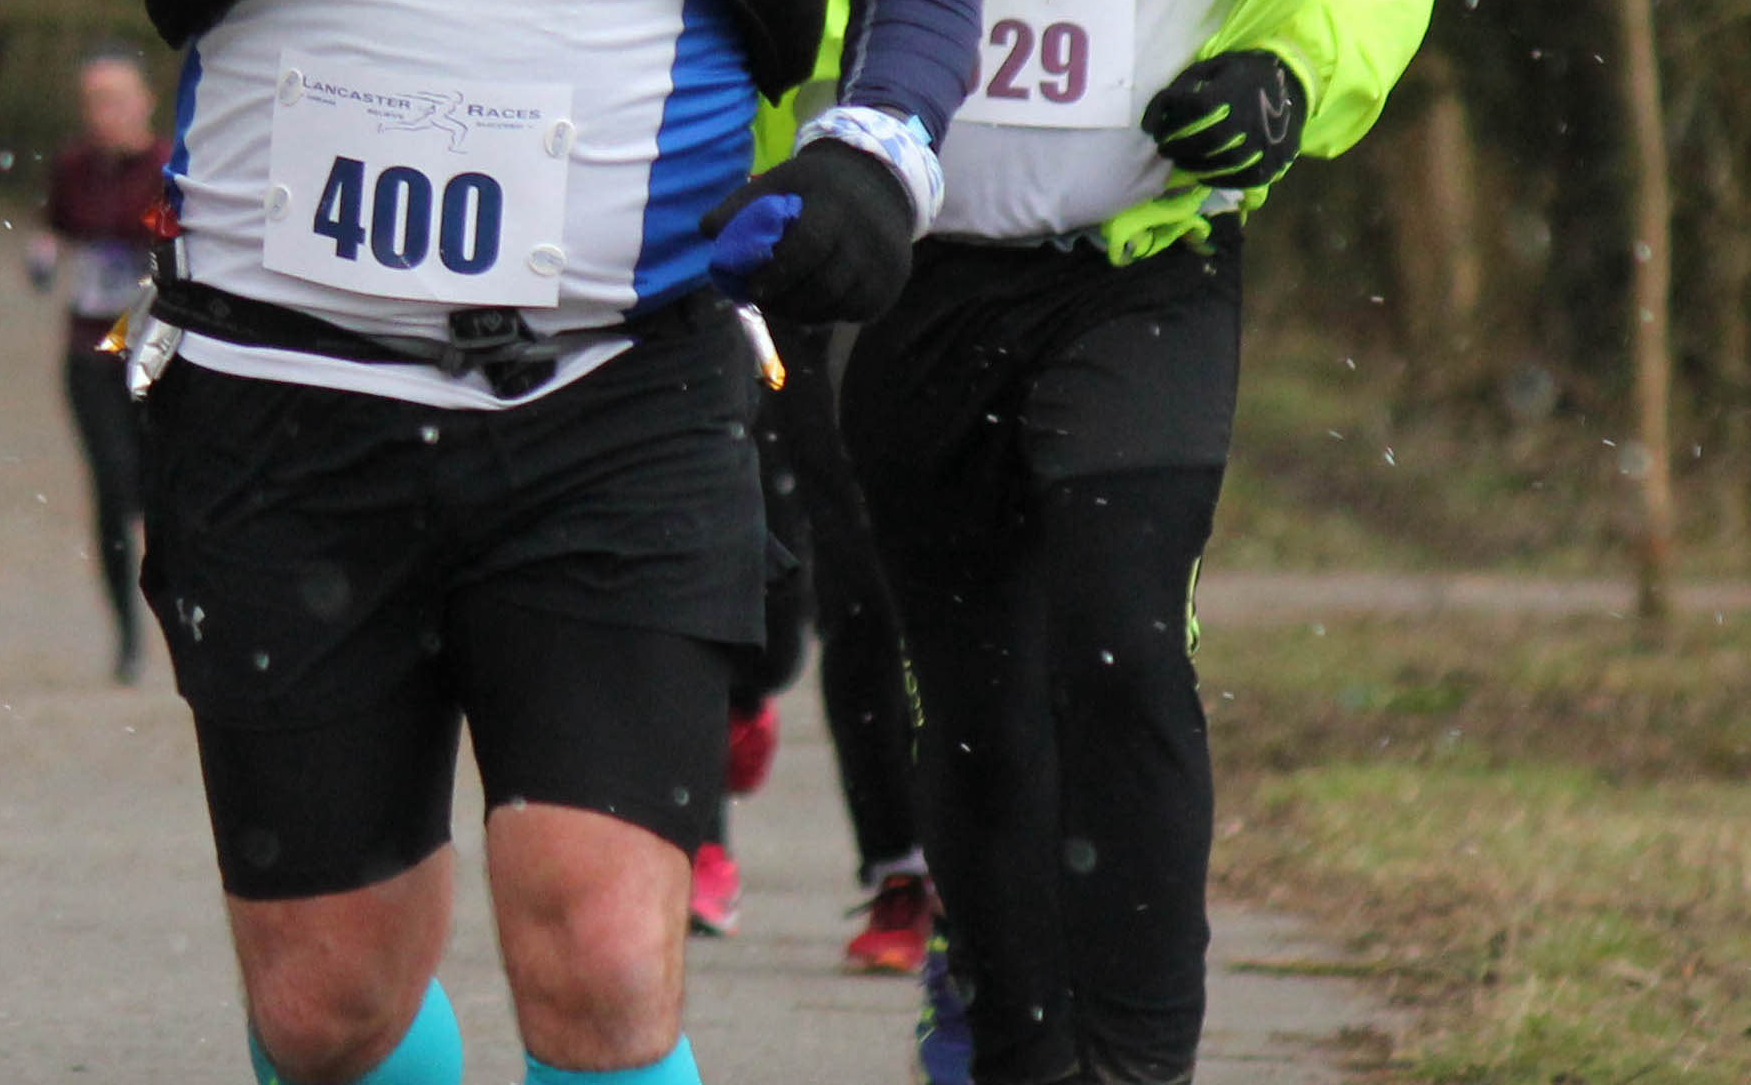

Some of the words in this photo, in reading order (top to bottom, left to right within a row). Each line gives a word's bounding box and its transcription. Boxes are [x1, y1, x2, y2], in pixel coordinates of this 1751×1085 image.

[302, 75, 411, 110] LANCASTER
[467, 103, 543, 120] RACES
[967, 18, 1090, 105] 29
[312, 155, 504, 275] 400
